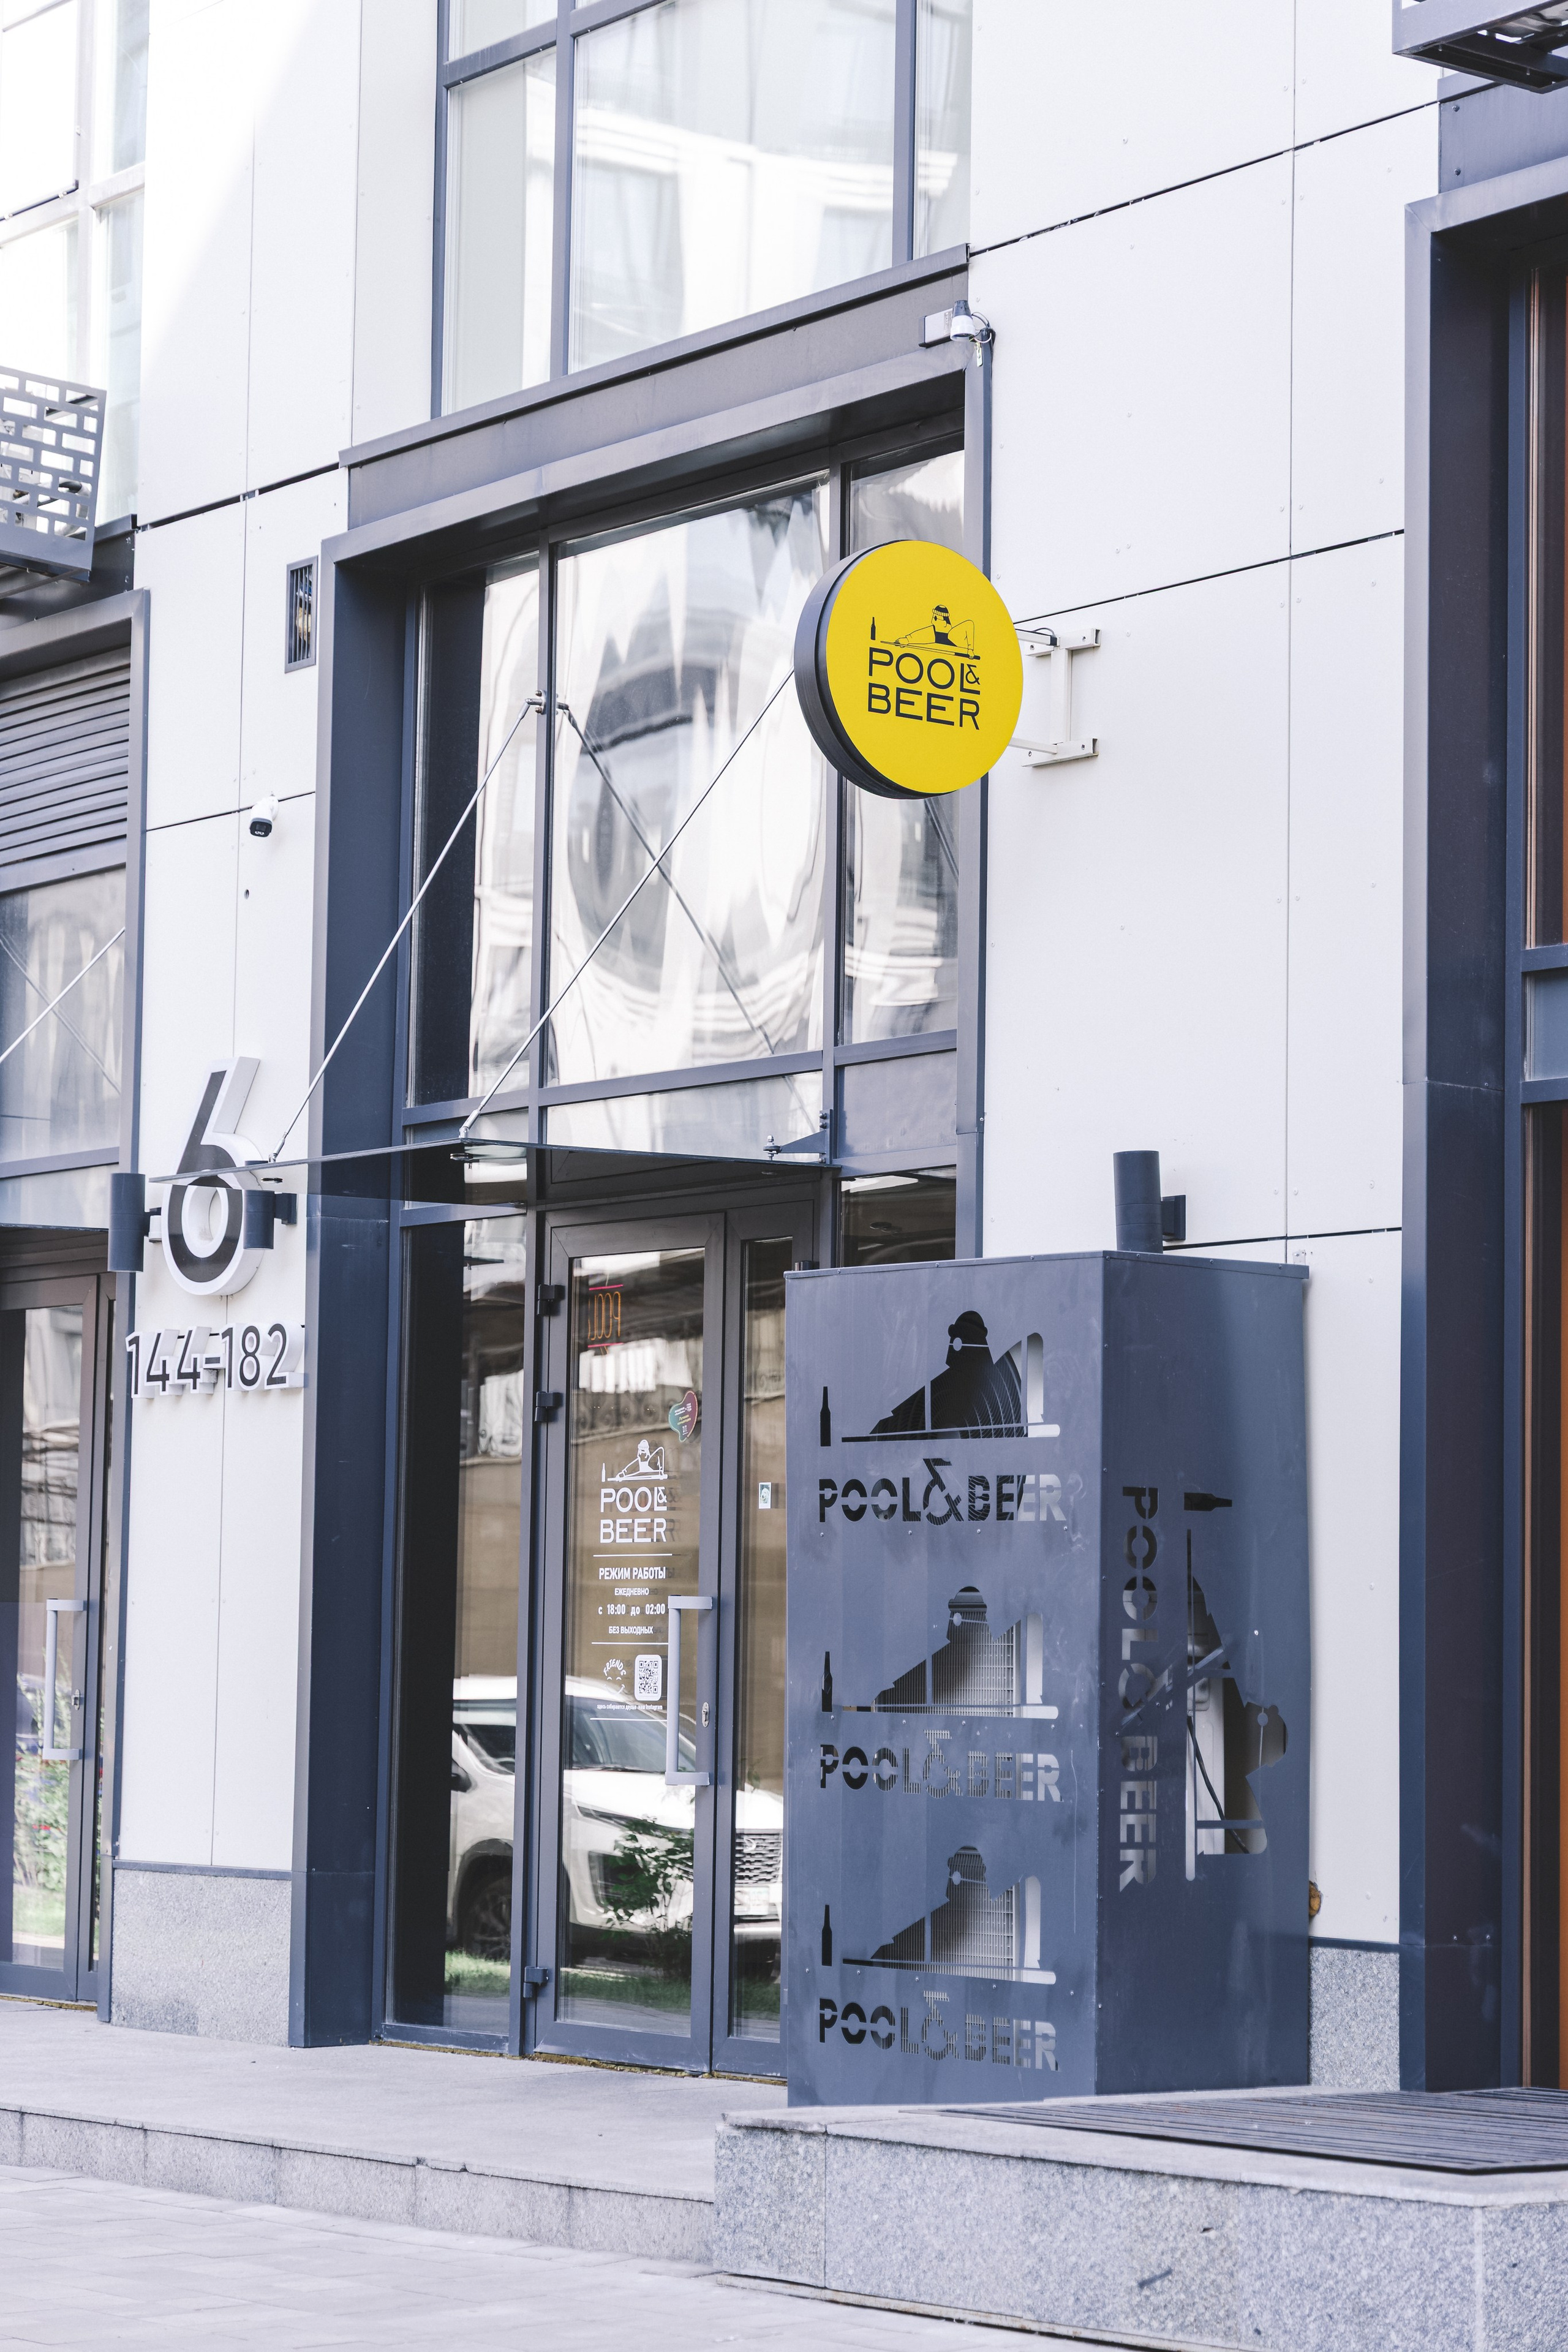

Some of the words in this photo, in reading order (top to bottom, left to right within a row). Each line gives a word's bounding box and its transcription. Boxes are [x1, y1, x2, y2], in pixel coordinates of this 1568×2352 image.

[868, 682, 980, 730] BEER
[162, 1060, 254, 1294] 6
[126, 1321, 288, 1399] 144-182
[600, 1518, 667, 1543] BEER
[599, 1567, 631, 1580] РЕЖИМ
[632, 1566, 666, 1580] РАБОТЫ
[614, 1588, 649, 1597] ЕЖЕДНЕВНО
[598, 1606, 603, 1615] с
[607, 1604, 626, 1615] 18:00
[630, 1606, 641, 1616] до
[645, 1604, 666, 1615] 02:00
[608, 1626, 620, 1634] БЕЗ
[620, 1626, 654, 1635] ВЫХОДНЫХ
[603, 1659, 627, 1676] FRIENDS
